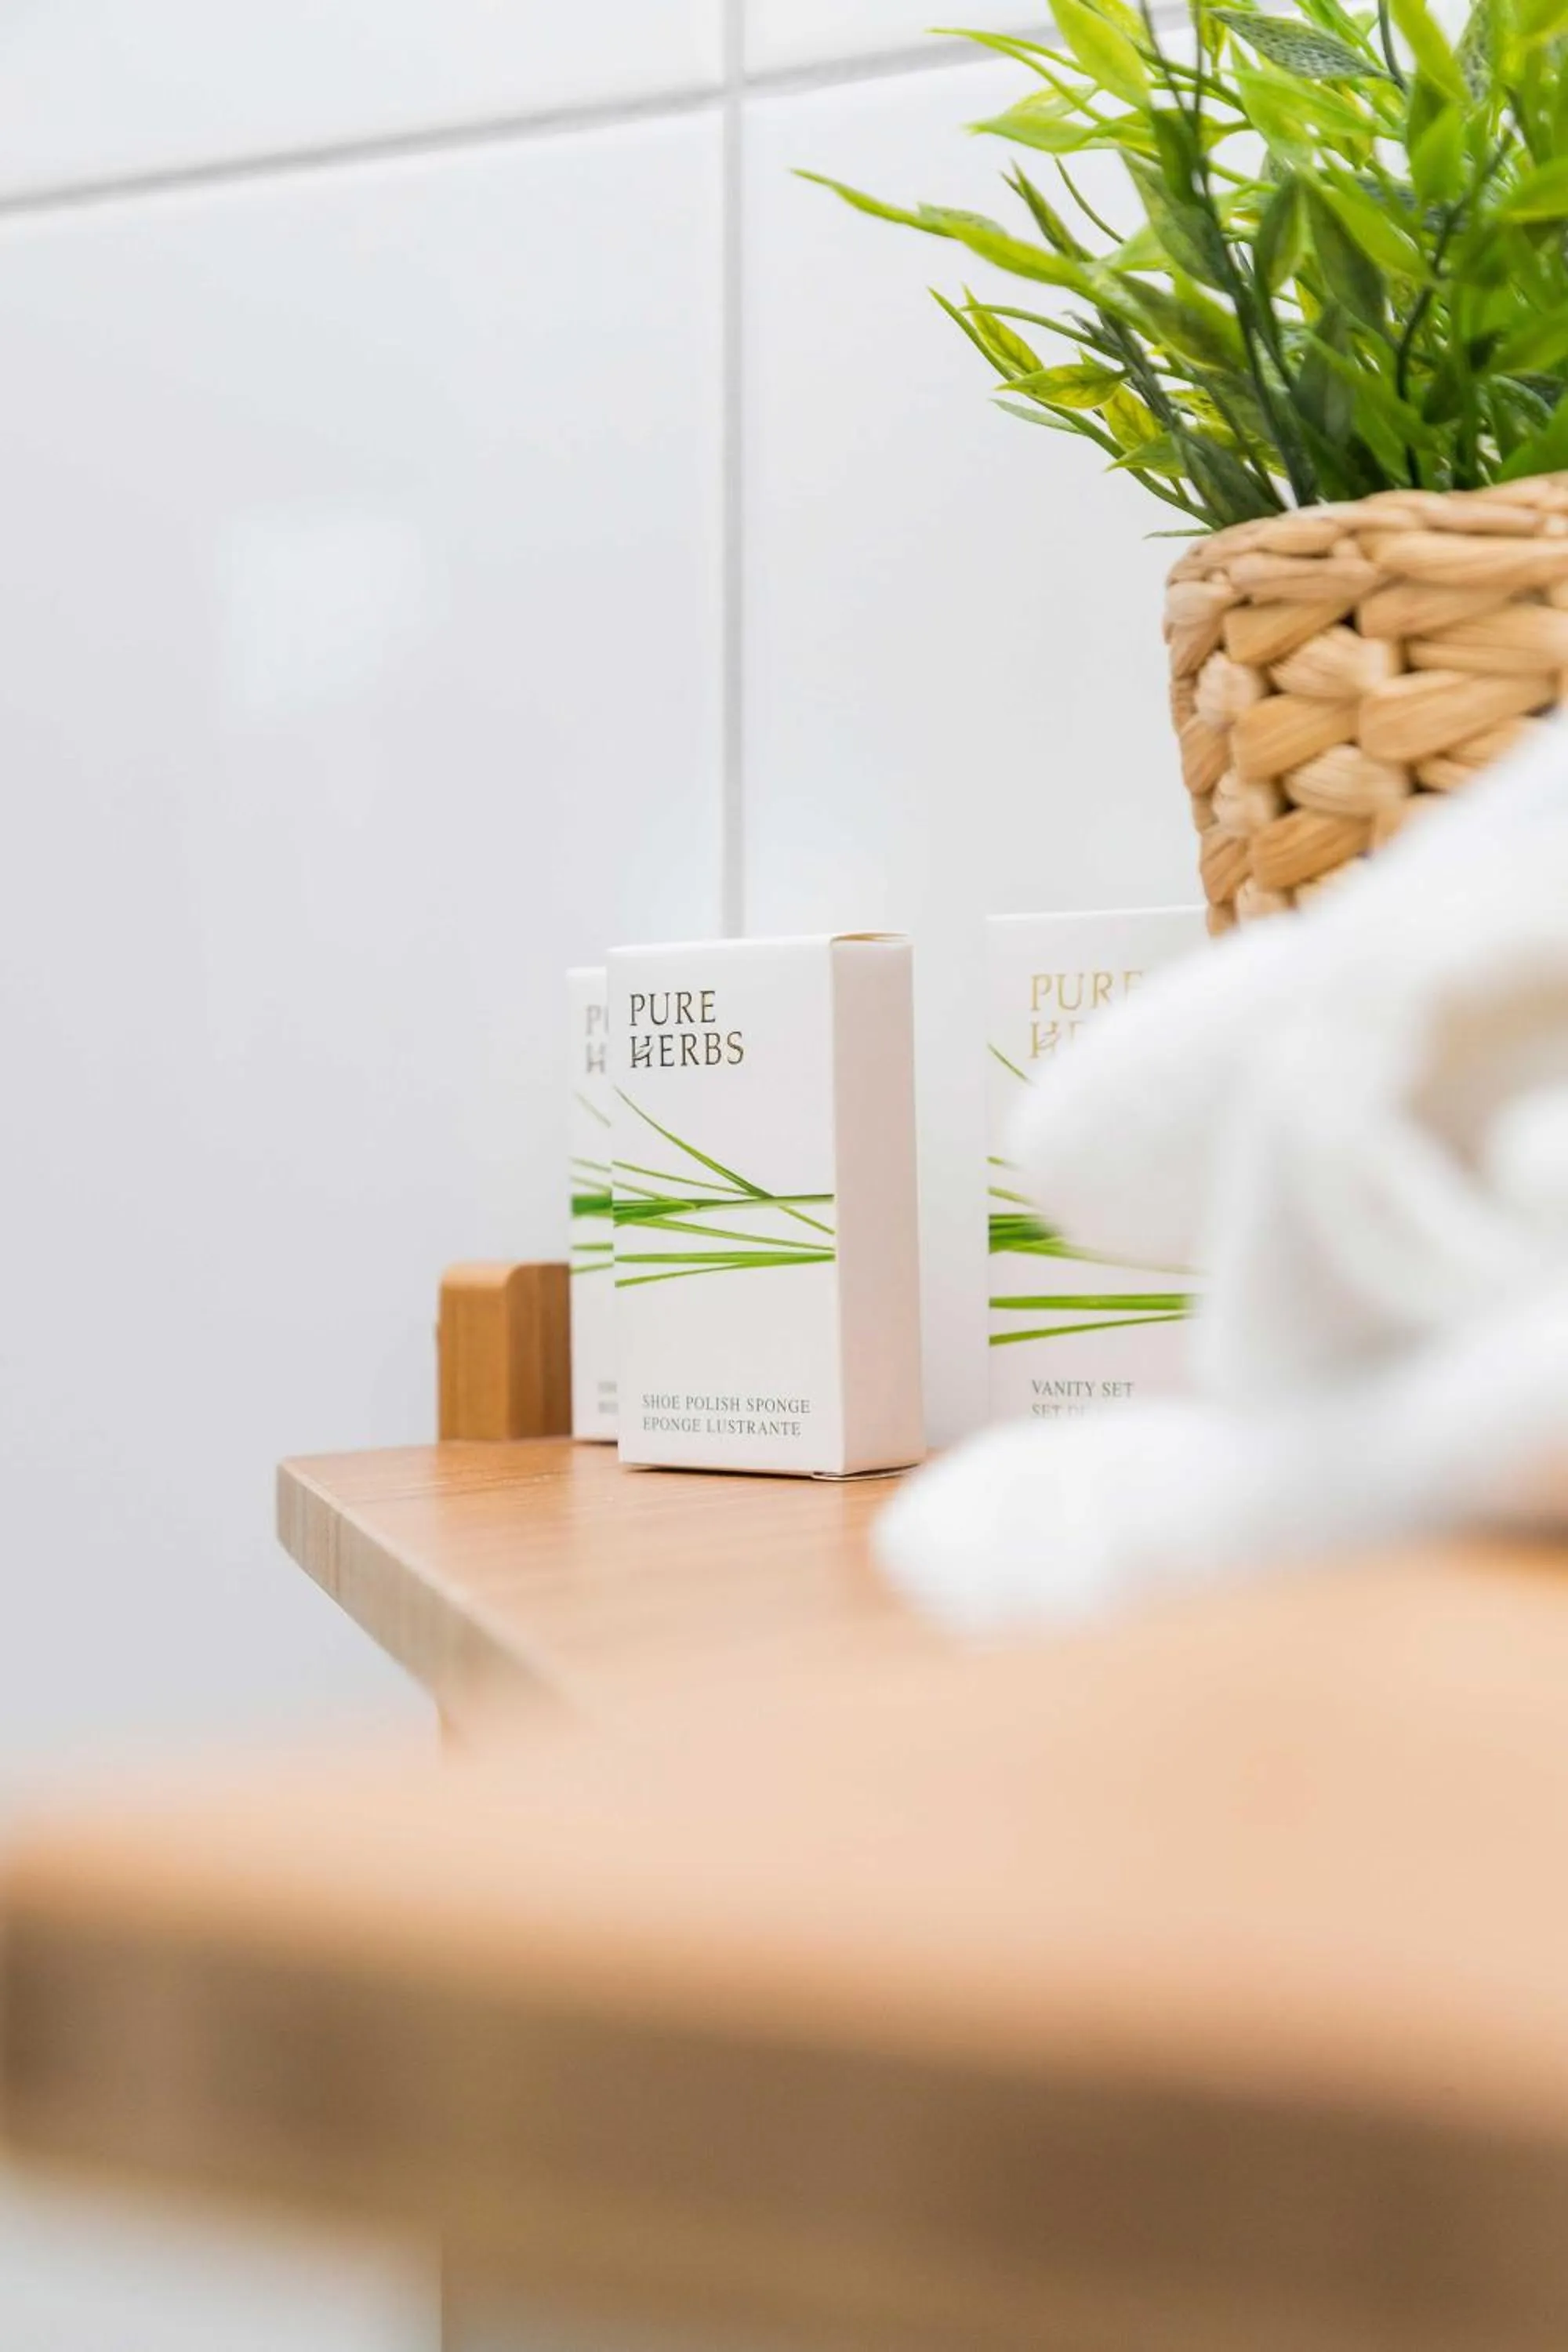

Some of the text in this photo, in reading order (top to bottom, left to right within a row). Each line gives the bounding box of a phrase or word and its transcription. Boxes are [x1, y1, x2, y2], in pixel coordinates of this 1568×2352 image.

[630, 990, 717, 1026] PURE
[630, 1031, 745, 1068] HERBS
[1031, 1379, 1134, 1398] VANITY SET
[641, 1394, 811, 1414] SHOE POLISH SPONGE
[642, 1417, 801, 1436] EPONGE LUSTRANTE
